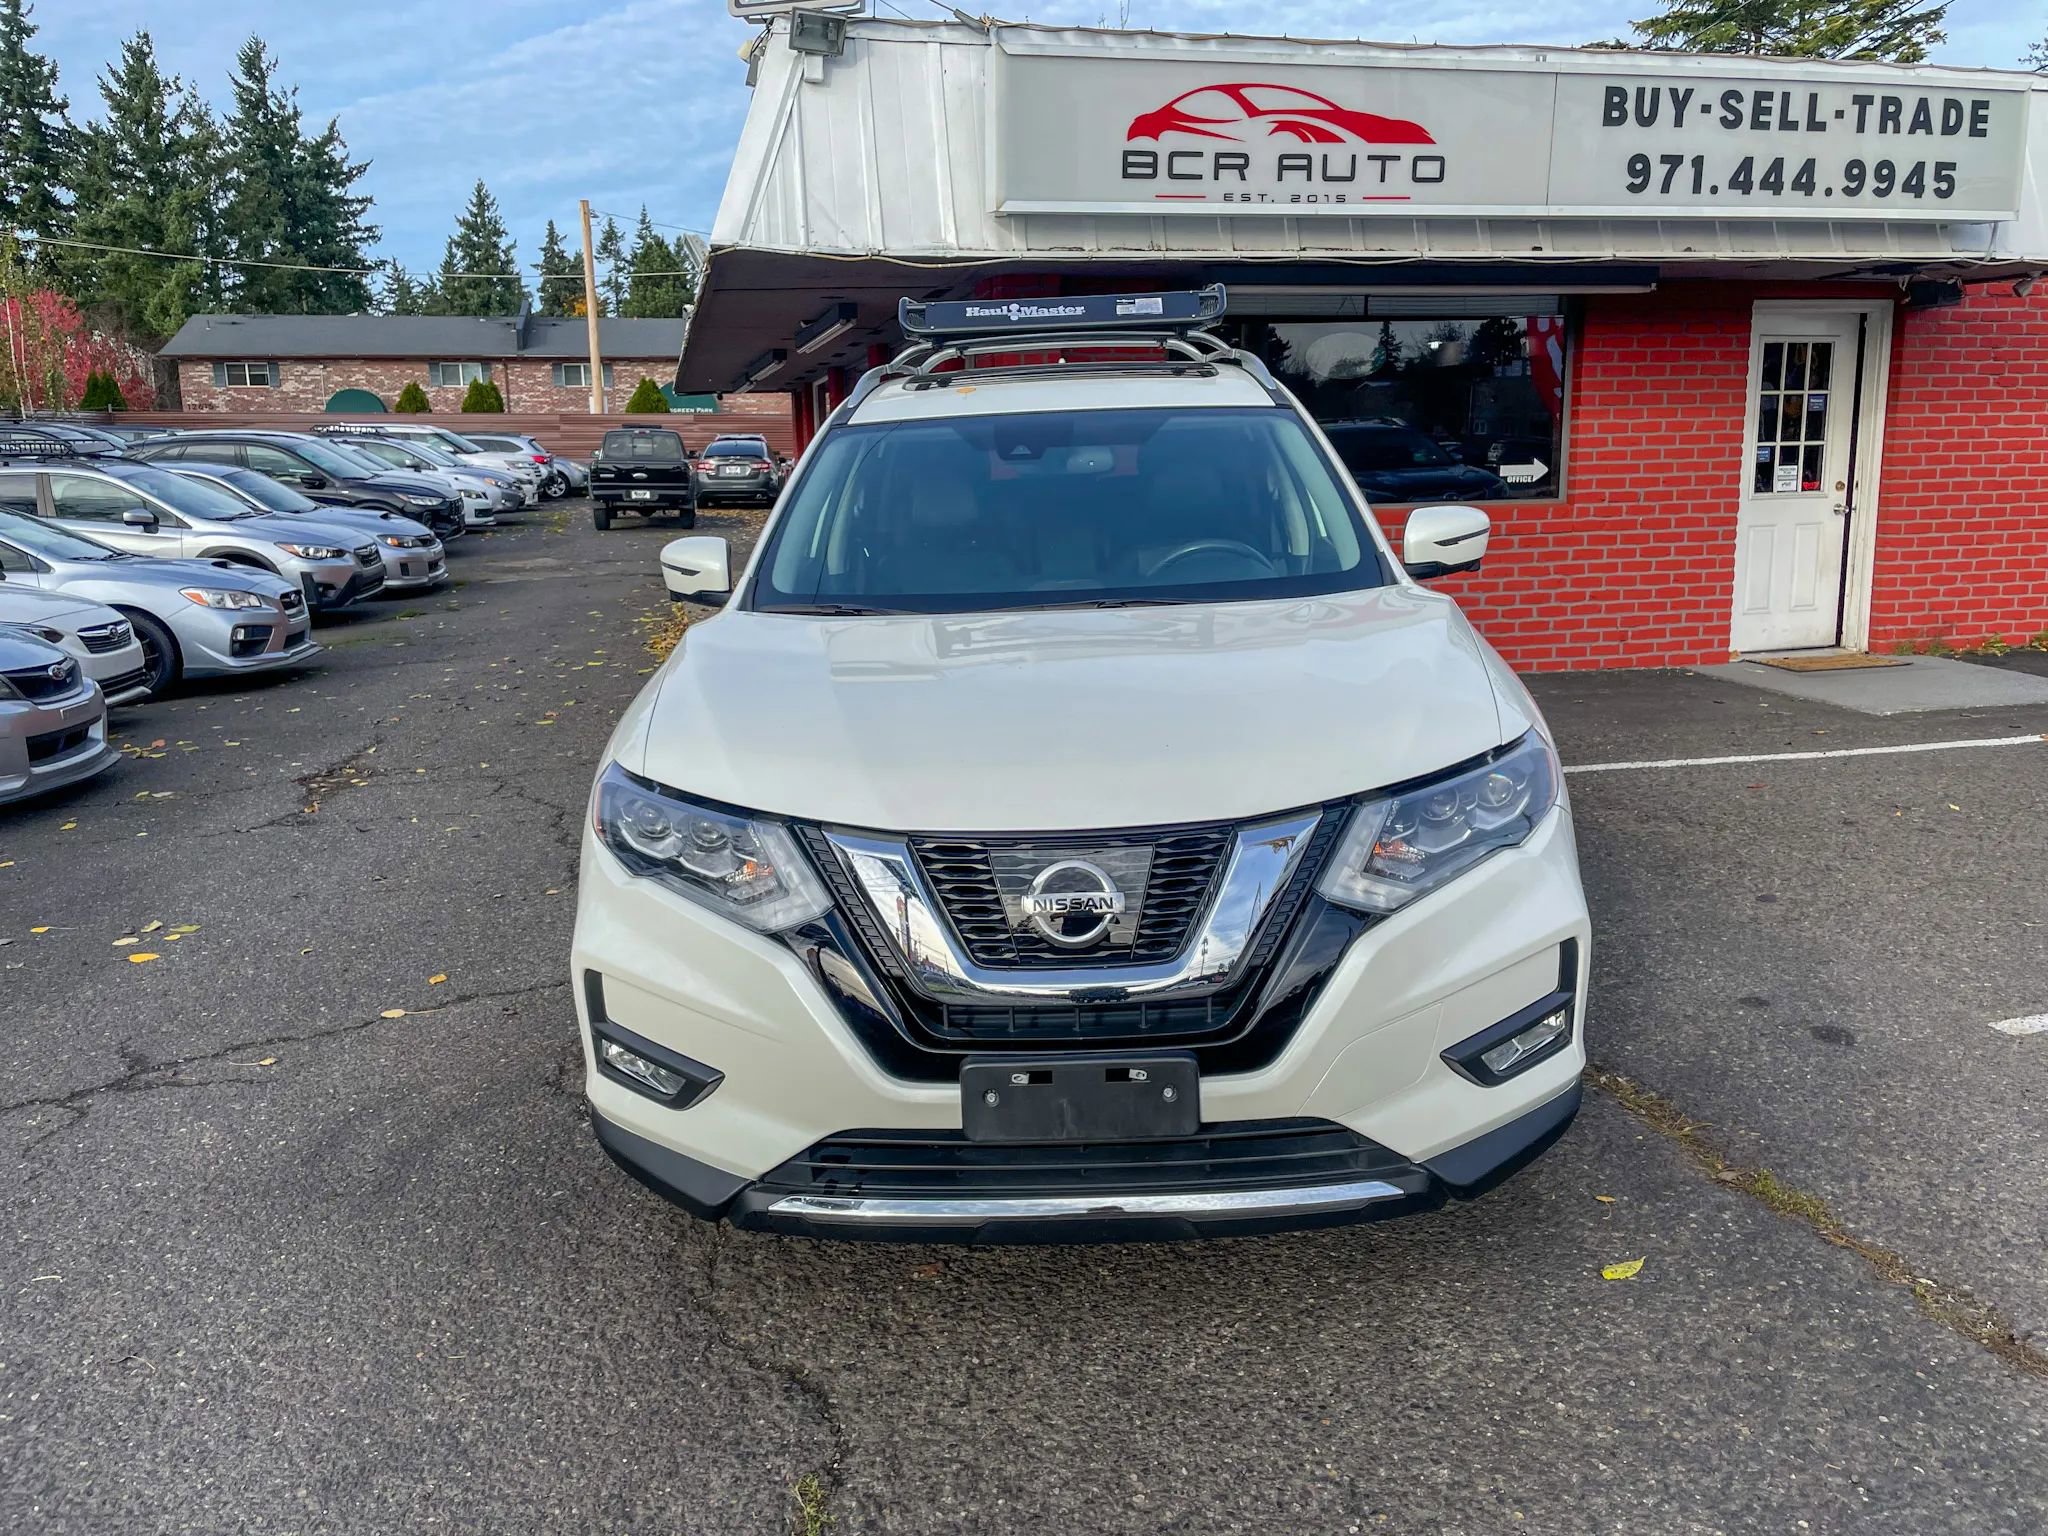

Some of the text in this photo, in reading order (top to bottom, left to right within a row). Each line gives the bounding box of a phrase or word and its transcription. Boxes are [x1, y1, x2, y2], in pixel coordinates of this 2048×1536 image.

[1122, 149, 1446, 184] BCR AUTO
[1625, 152, 1958, 200] 971.444.9945
[1223, 192, 1347, 204] EST. 2015
[965, 304, 1084, 318] Haul Master
[1506, 475, 1532, 483] OFFICE
[1033, 896, 1113, 912] NISSAN
